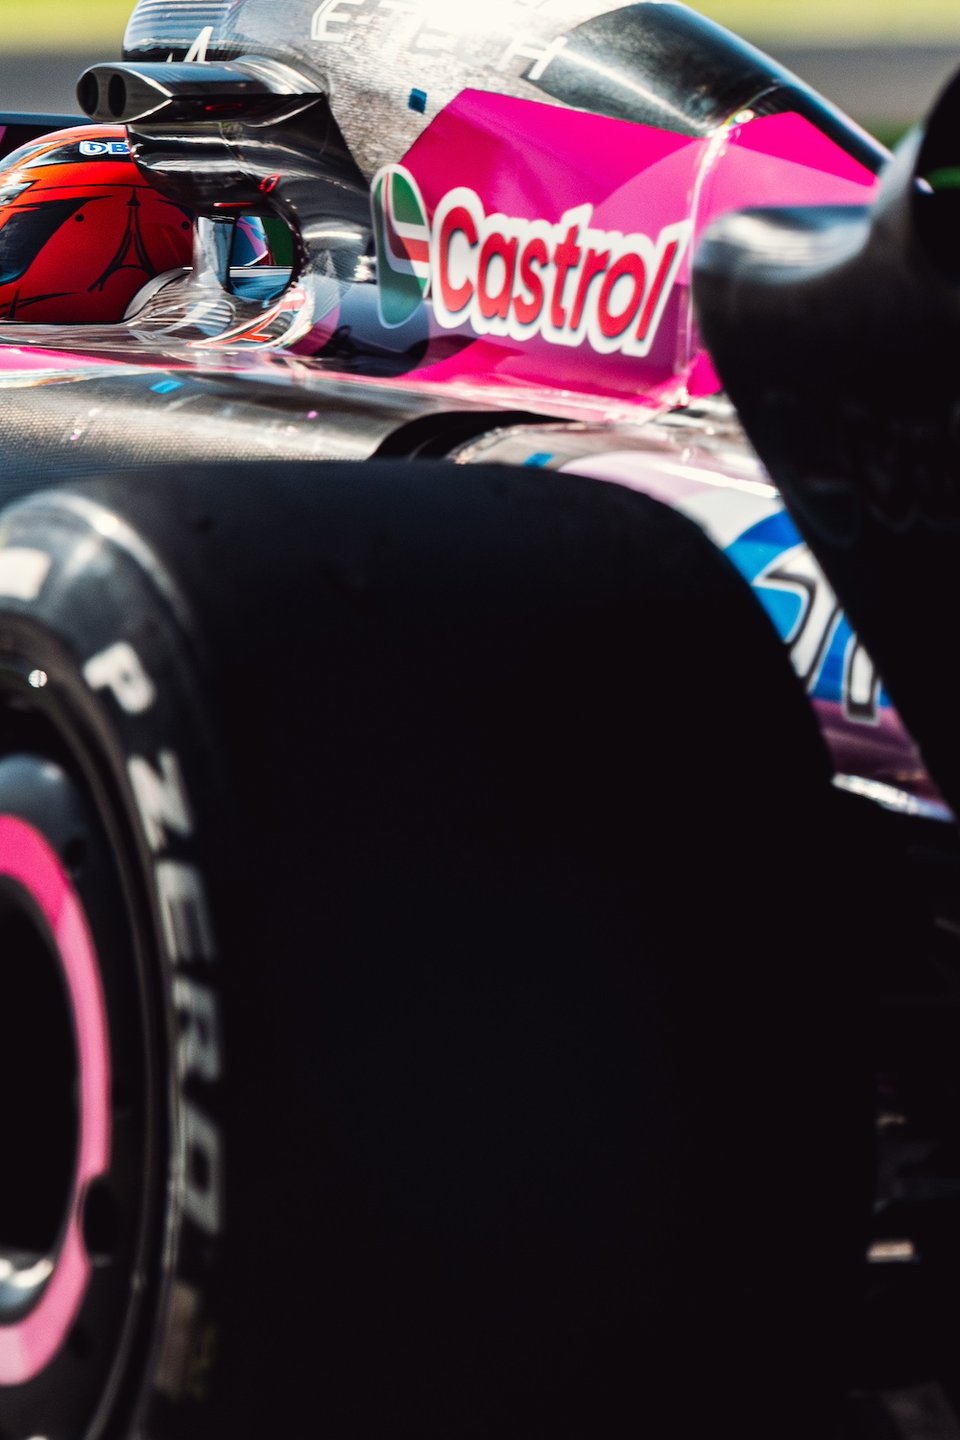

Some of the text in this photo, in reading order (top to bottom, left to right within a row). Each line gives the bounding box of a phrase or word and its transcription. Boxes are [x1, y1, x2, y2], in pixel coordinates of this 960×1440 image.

[437, 202, 682, 344] Castrol
[82, 640, 224, 1236] P ZERO
